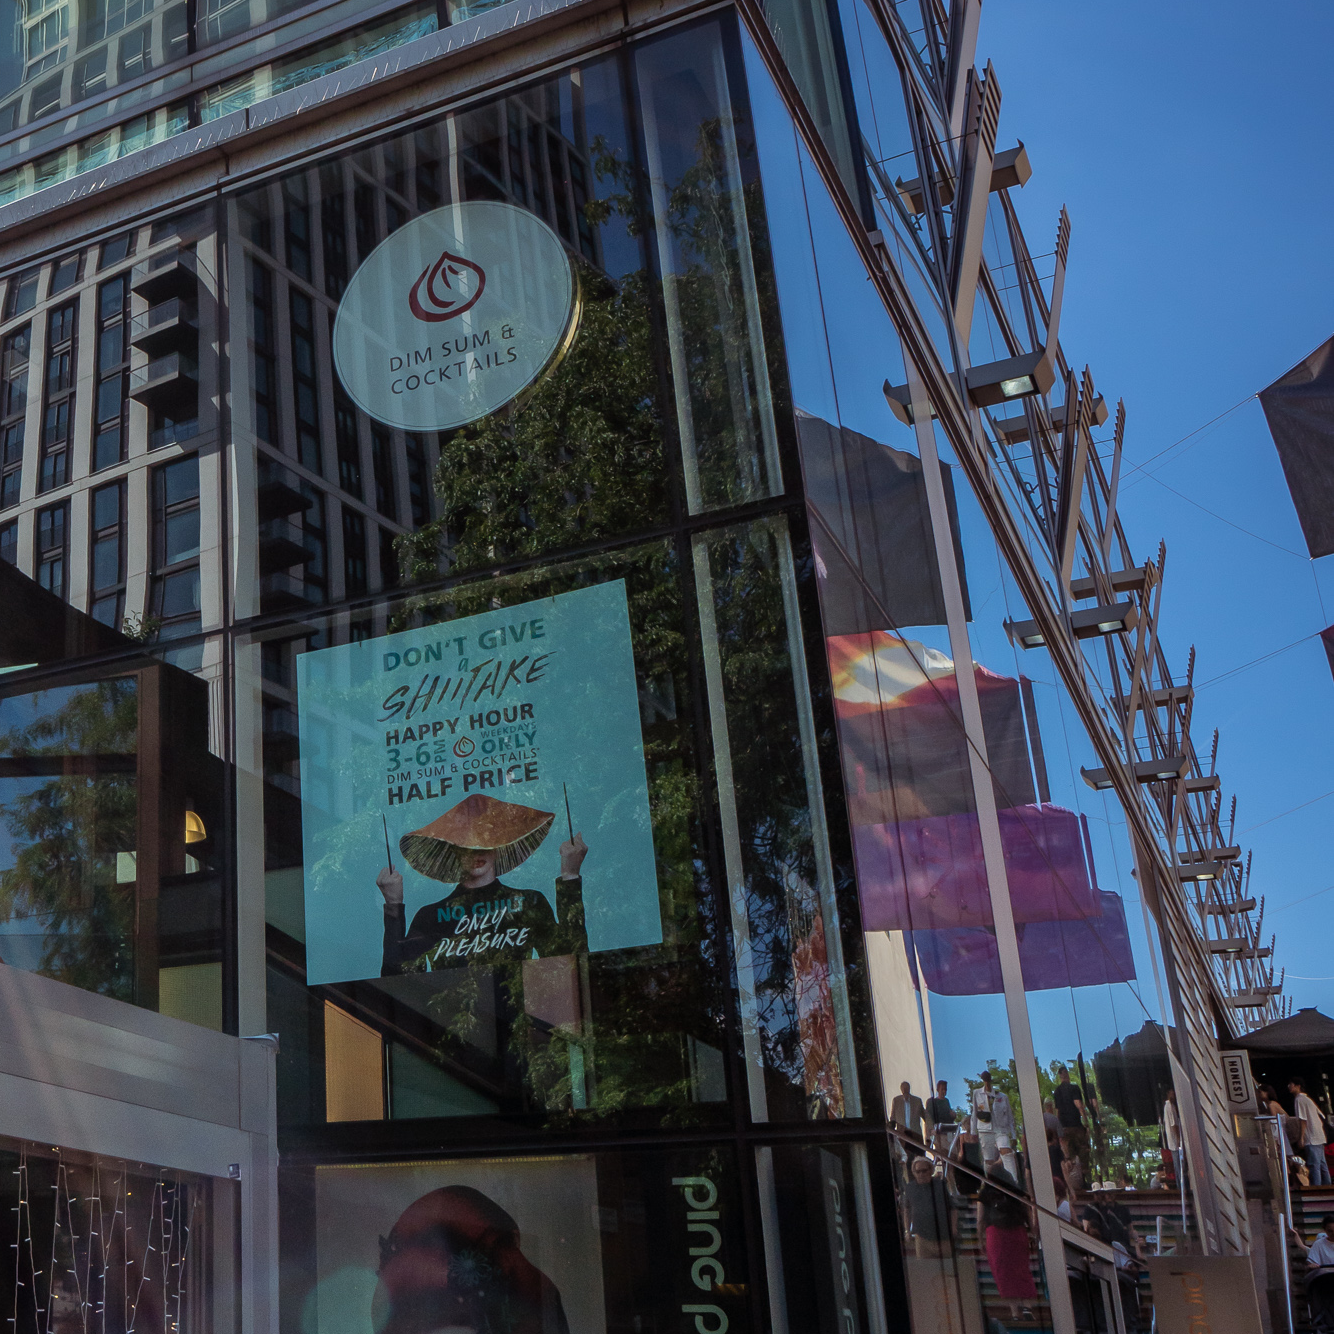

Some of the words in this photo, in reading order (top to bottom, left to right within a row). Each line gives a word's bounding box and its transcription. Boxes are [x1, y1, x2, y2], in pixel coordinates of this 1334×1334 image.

[390, 347, 432, 372] DIM
[442, 330, 491, 357] SUM
[501, 324, 515, 339] &
[391, 347, 517, 394] COCKTAILS
[383, 636, 468, 672] DON'T
[478, 618, 545, 650] GIVE
[458, 657, 469, 672] a
[377, 651, 557, 722] SHIITAKE
[386, 717, 460, 746] HAPPY
[469, 703, 535, 730] HOUR
[481, 721, 537, 739] WEEKDAYS
[387, 742, 431, 772] 3-6
[434, 739, 446, 763] PM
[481, 730, 537, 754] ONLY
[387, 771, 411, 784] DIM
[417, 766, 445, 779] SUM
[450, 763, 459, 773] &
[388, 777, 453, 806] HALF
[463, 761, 539, 792] PRICE
[437, 905, 465, 923] NO
[472, 896, 526, 918] GUILT
[454, 905, 507, 934] ONLY
[433, 927, 530, 961] PLEASURE
[1228, 1060, 1244, 1097] HONEST
